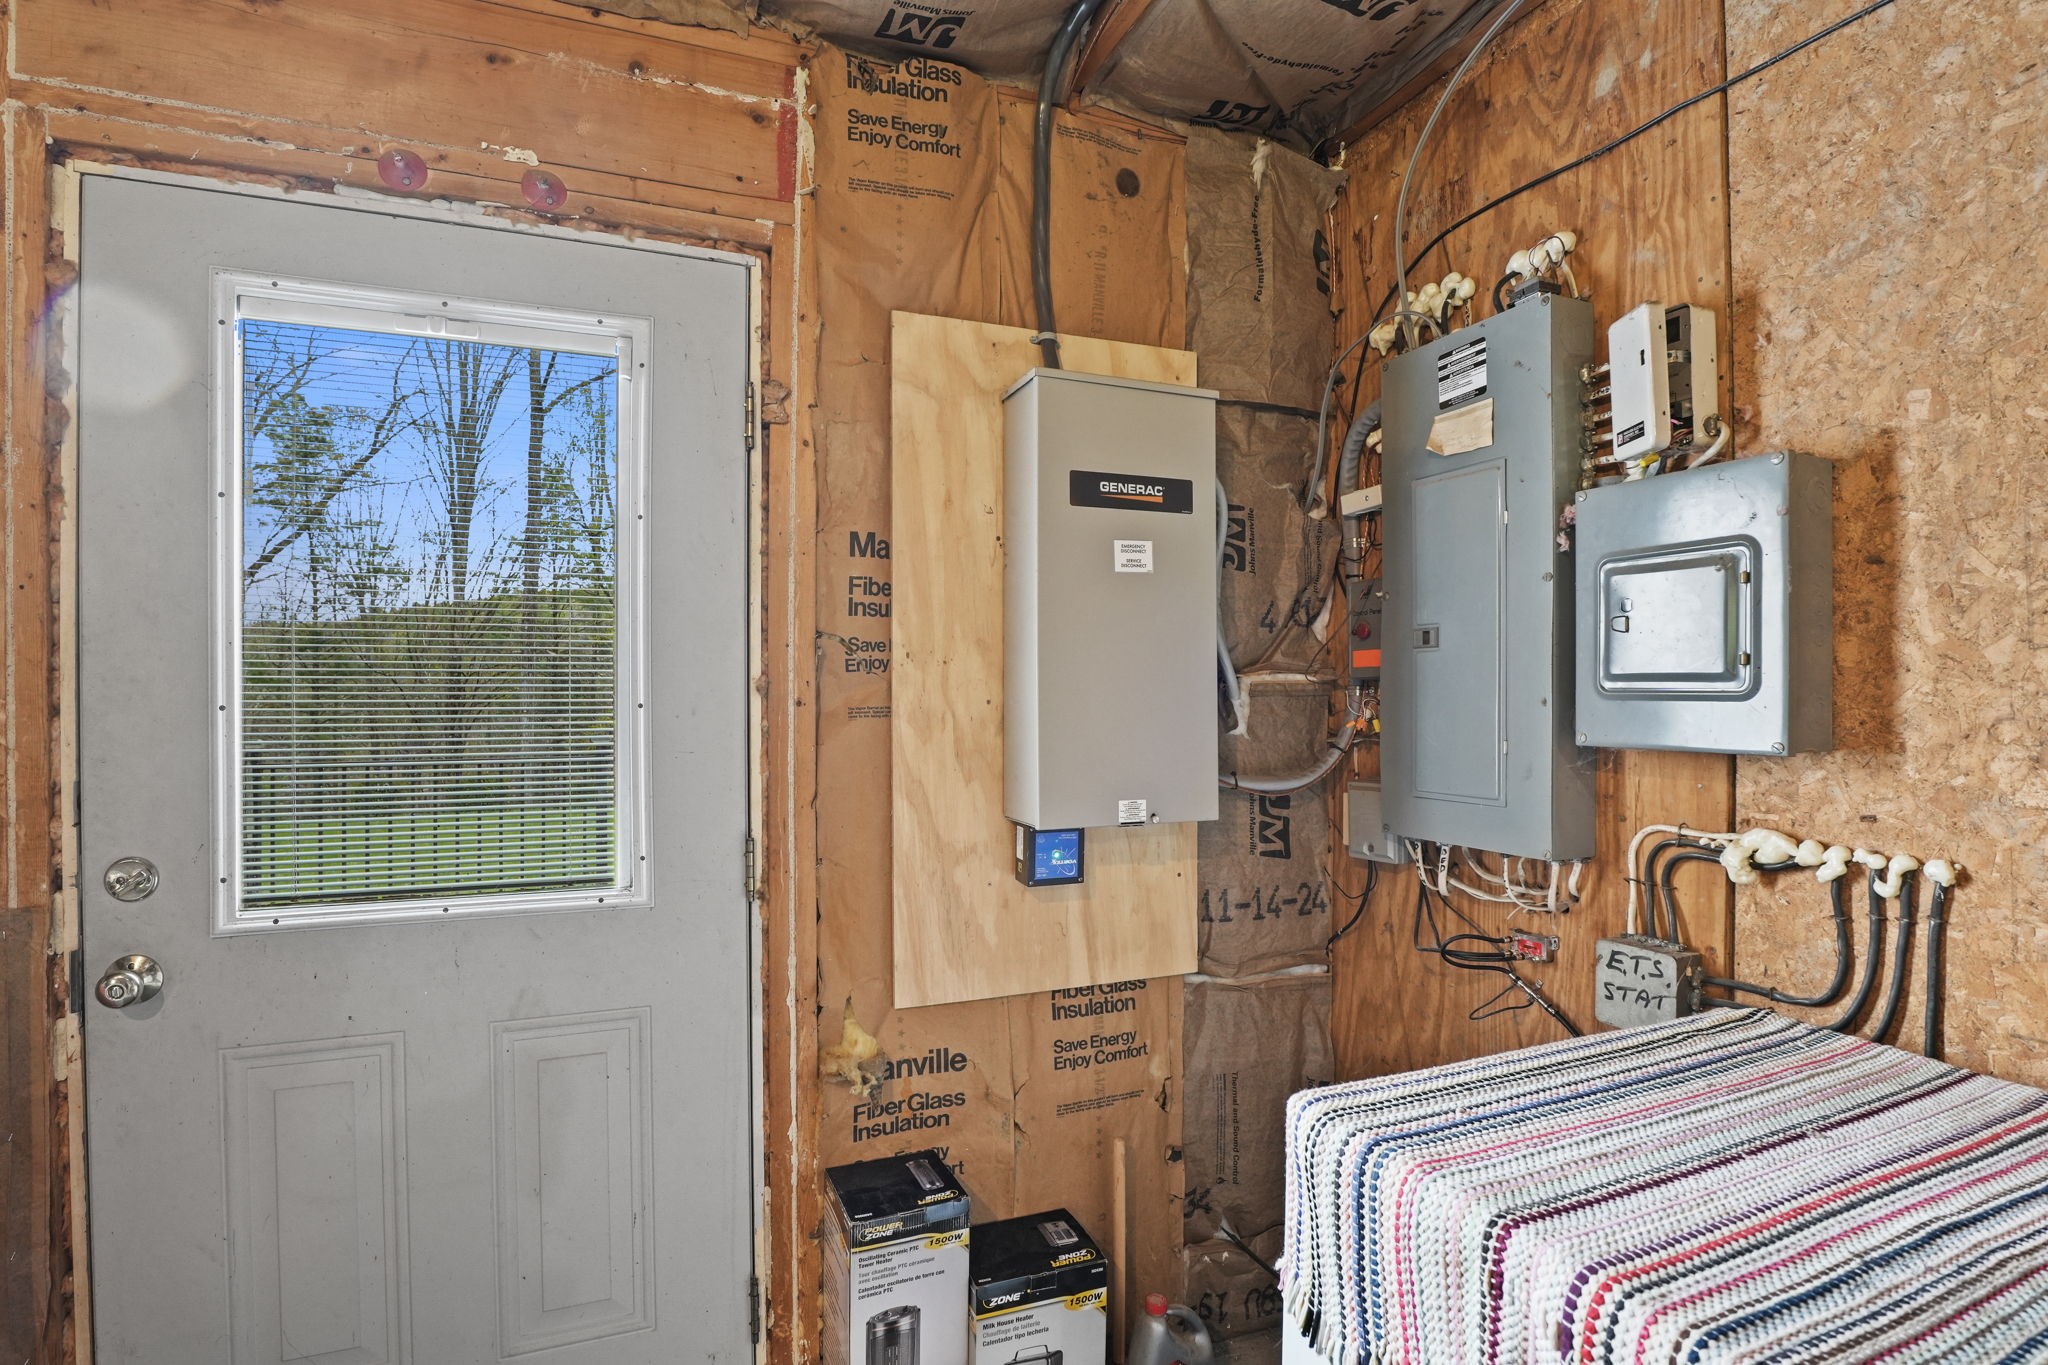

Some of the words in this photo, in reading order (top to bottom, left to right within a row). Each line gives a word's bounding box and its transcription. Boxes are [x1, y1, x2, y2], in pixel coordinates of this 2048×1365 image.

[848, 108, 888, 128] Save
[891, 115, 948, 139] Energy
[848, 126, 892, 149] Enjoy
[896, 134, 961, 158] Comfort
[1251, 194, 1265, 302] Formaldehyde-Free
[1100, 481, 1163, 496] GENERAC
[845, 636, 886, 656] Save
[845, 655, 890, 674] Enjoy
[1249, 793, 1257, 815] ohns
[1201, 881, 1328, 923] 11-14-24
[1604, 982, 1666, 1010] STAT
[1051, 996, 1136, 1021] Insulation
[1053, 1039, 1088, 1055] Save
[1090, 1031, 1137, 1049] Energy
[883, 1047, 968, 1080] anville
[1054, 1054, 1092, 1071] Enjoy
[1094, 1042, 1148, 1065] Comfort
[853, 1112, 950, 1143] Insulation
[864, 1221, 904, 1235] POWER
[865, 1229, 894, 1241] ZONE
[929, 1232, 964, 1246] 1500W
[887, 1248, 908, 1257] Ceramic
[858, 1261, 875, 1269] Tower
[875, 1257, 893, 1265] Heater
[897, 1262, 908, 1270] PTC
[989, 1292, 1021, 1307] ZONE
[1069, 1292, 1103, 1307] 1500W
[982, 1321, 996, 1331] Milk
[996, 1318, 1015, 1327] House
[1015, 1314, 1034, 1323] Heater
[982, 1335, 1013, 1347] Calentador
[1014, 1331, 1026, 1340] tipo
